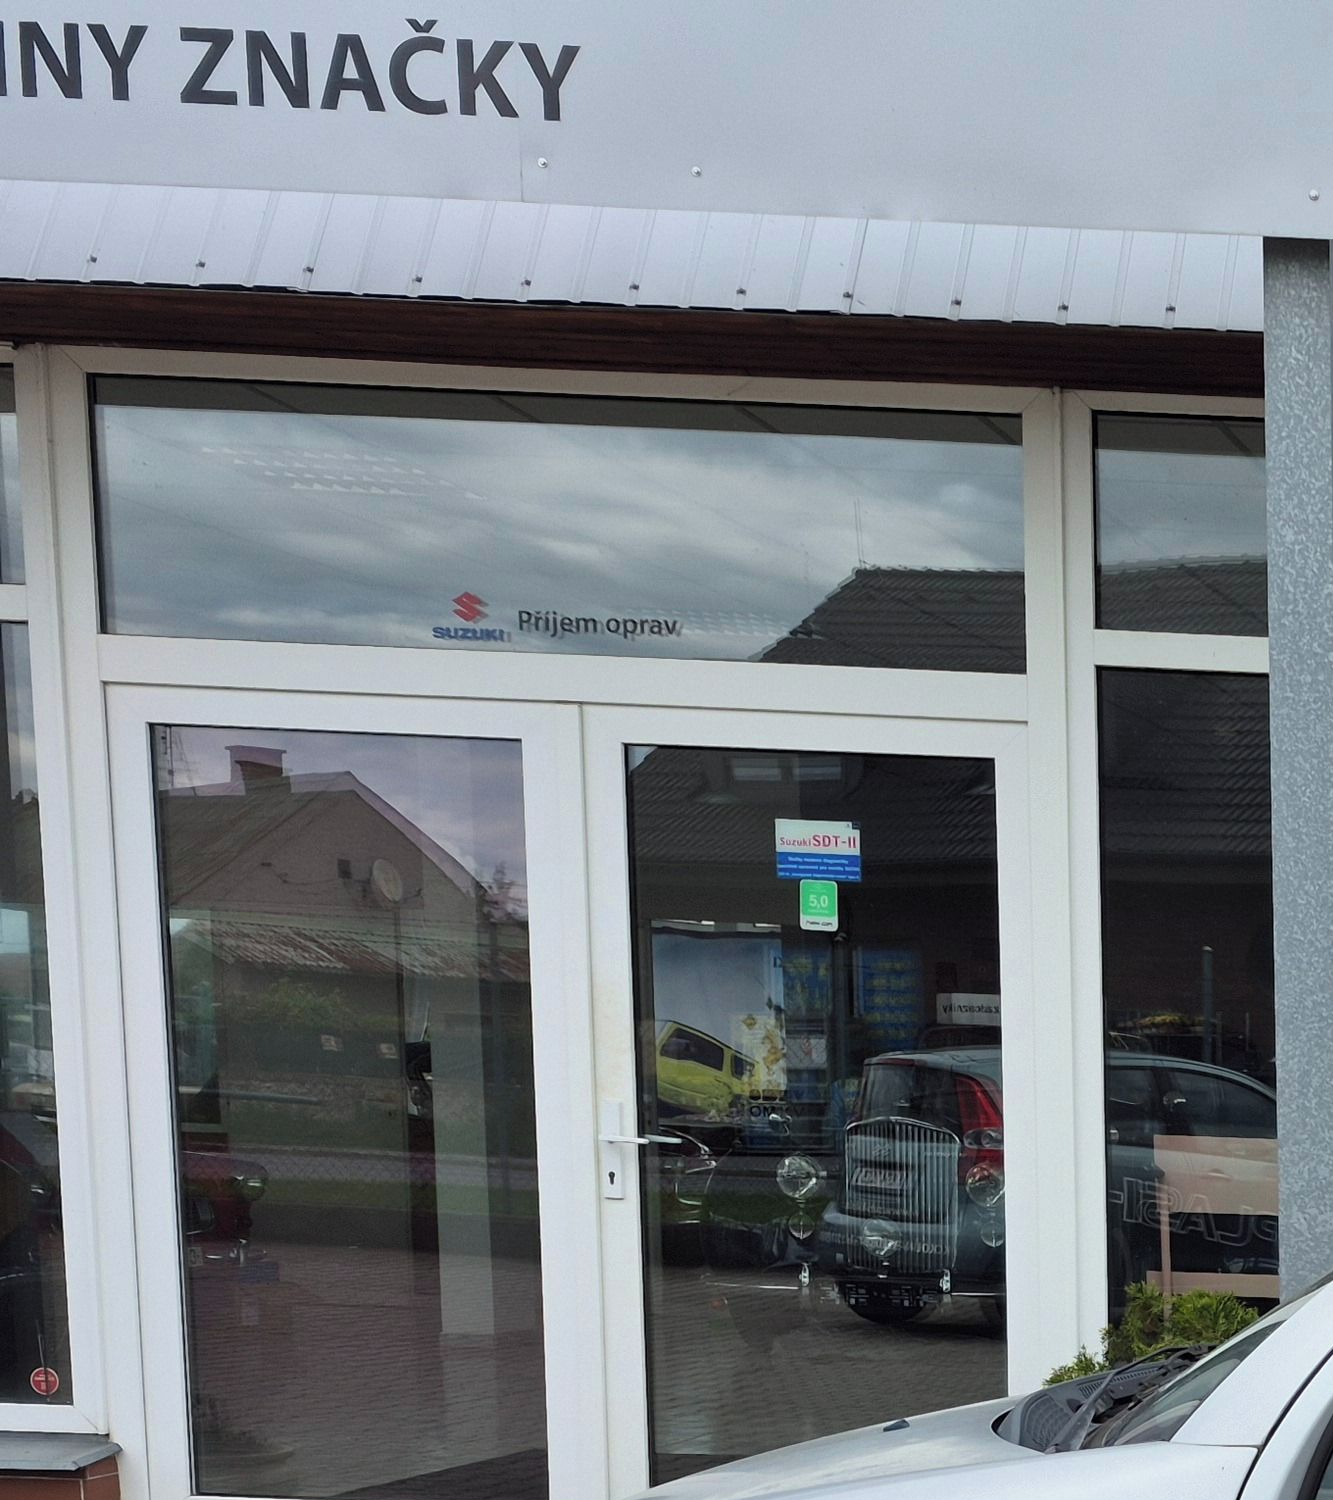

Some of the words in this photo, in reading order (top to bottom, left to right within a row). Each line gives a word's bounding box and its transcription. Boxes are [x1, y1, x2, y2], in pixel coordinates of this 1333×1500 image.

[0, 21, 148, 101] NY
[179, 18, 581, 122] ZNAČKY
[517, 609, 597, 637] Příjem
[605, 616, 678, 639] oprav
[432, 626, 504, 642] SUZUKI
[779, 836, 811, 847] Suzuki
[812, 834, 857, 849] SDT-II
[808, 894, 829, 910] 5,0
